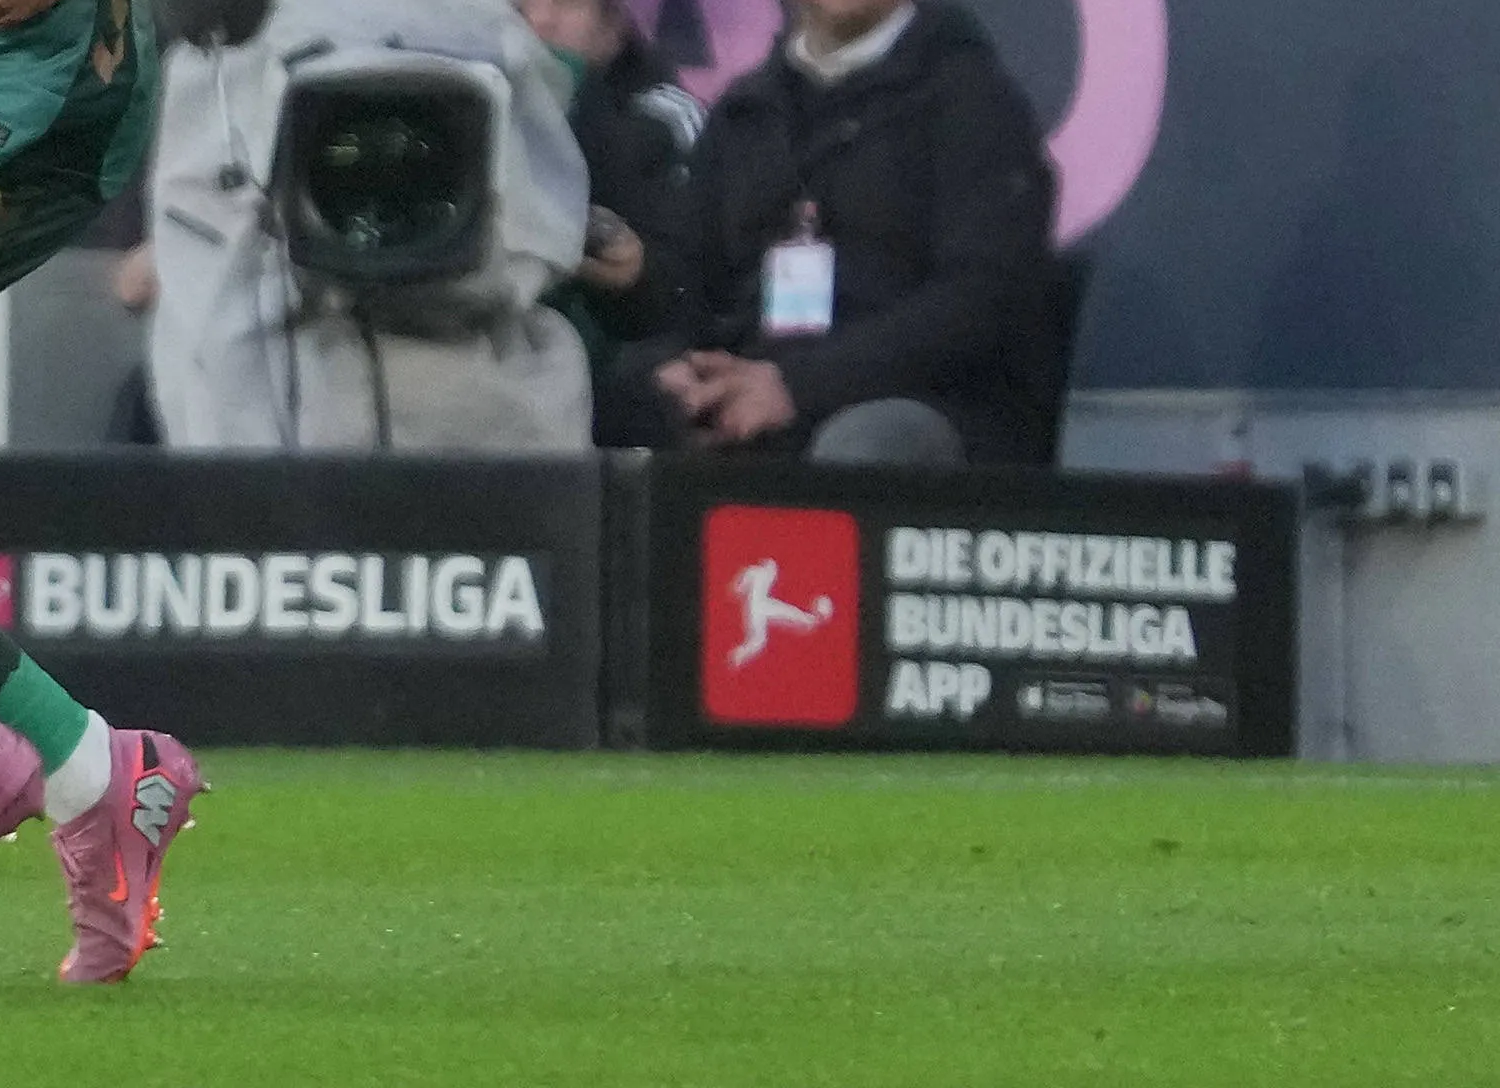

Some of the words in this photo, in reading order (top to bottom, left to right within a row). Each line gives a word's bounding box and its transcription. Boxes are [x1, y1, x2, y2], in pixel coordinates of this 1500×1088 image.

[23, 552, 545, 638] BUNDESLIGA
[885, 525, 972, 588] DIE
[976, 529, 1238, 602] OFFIZIELLE
[885, 592, 1198, 662] BUNDESLIGA
[885, 662, 992, 718] APP
